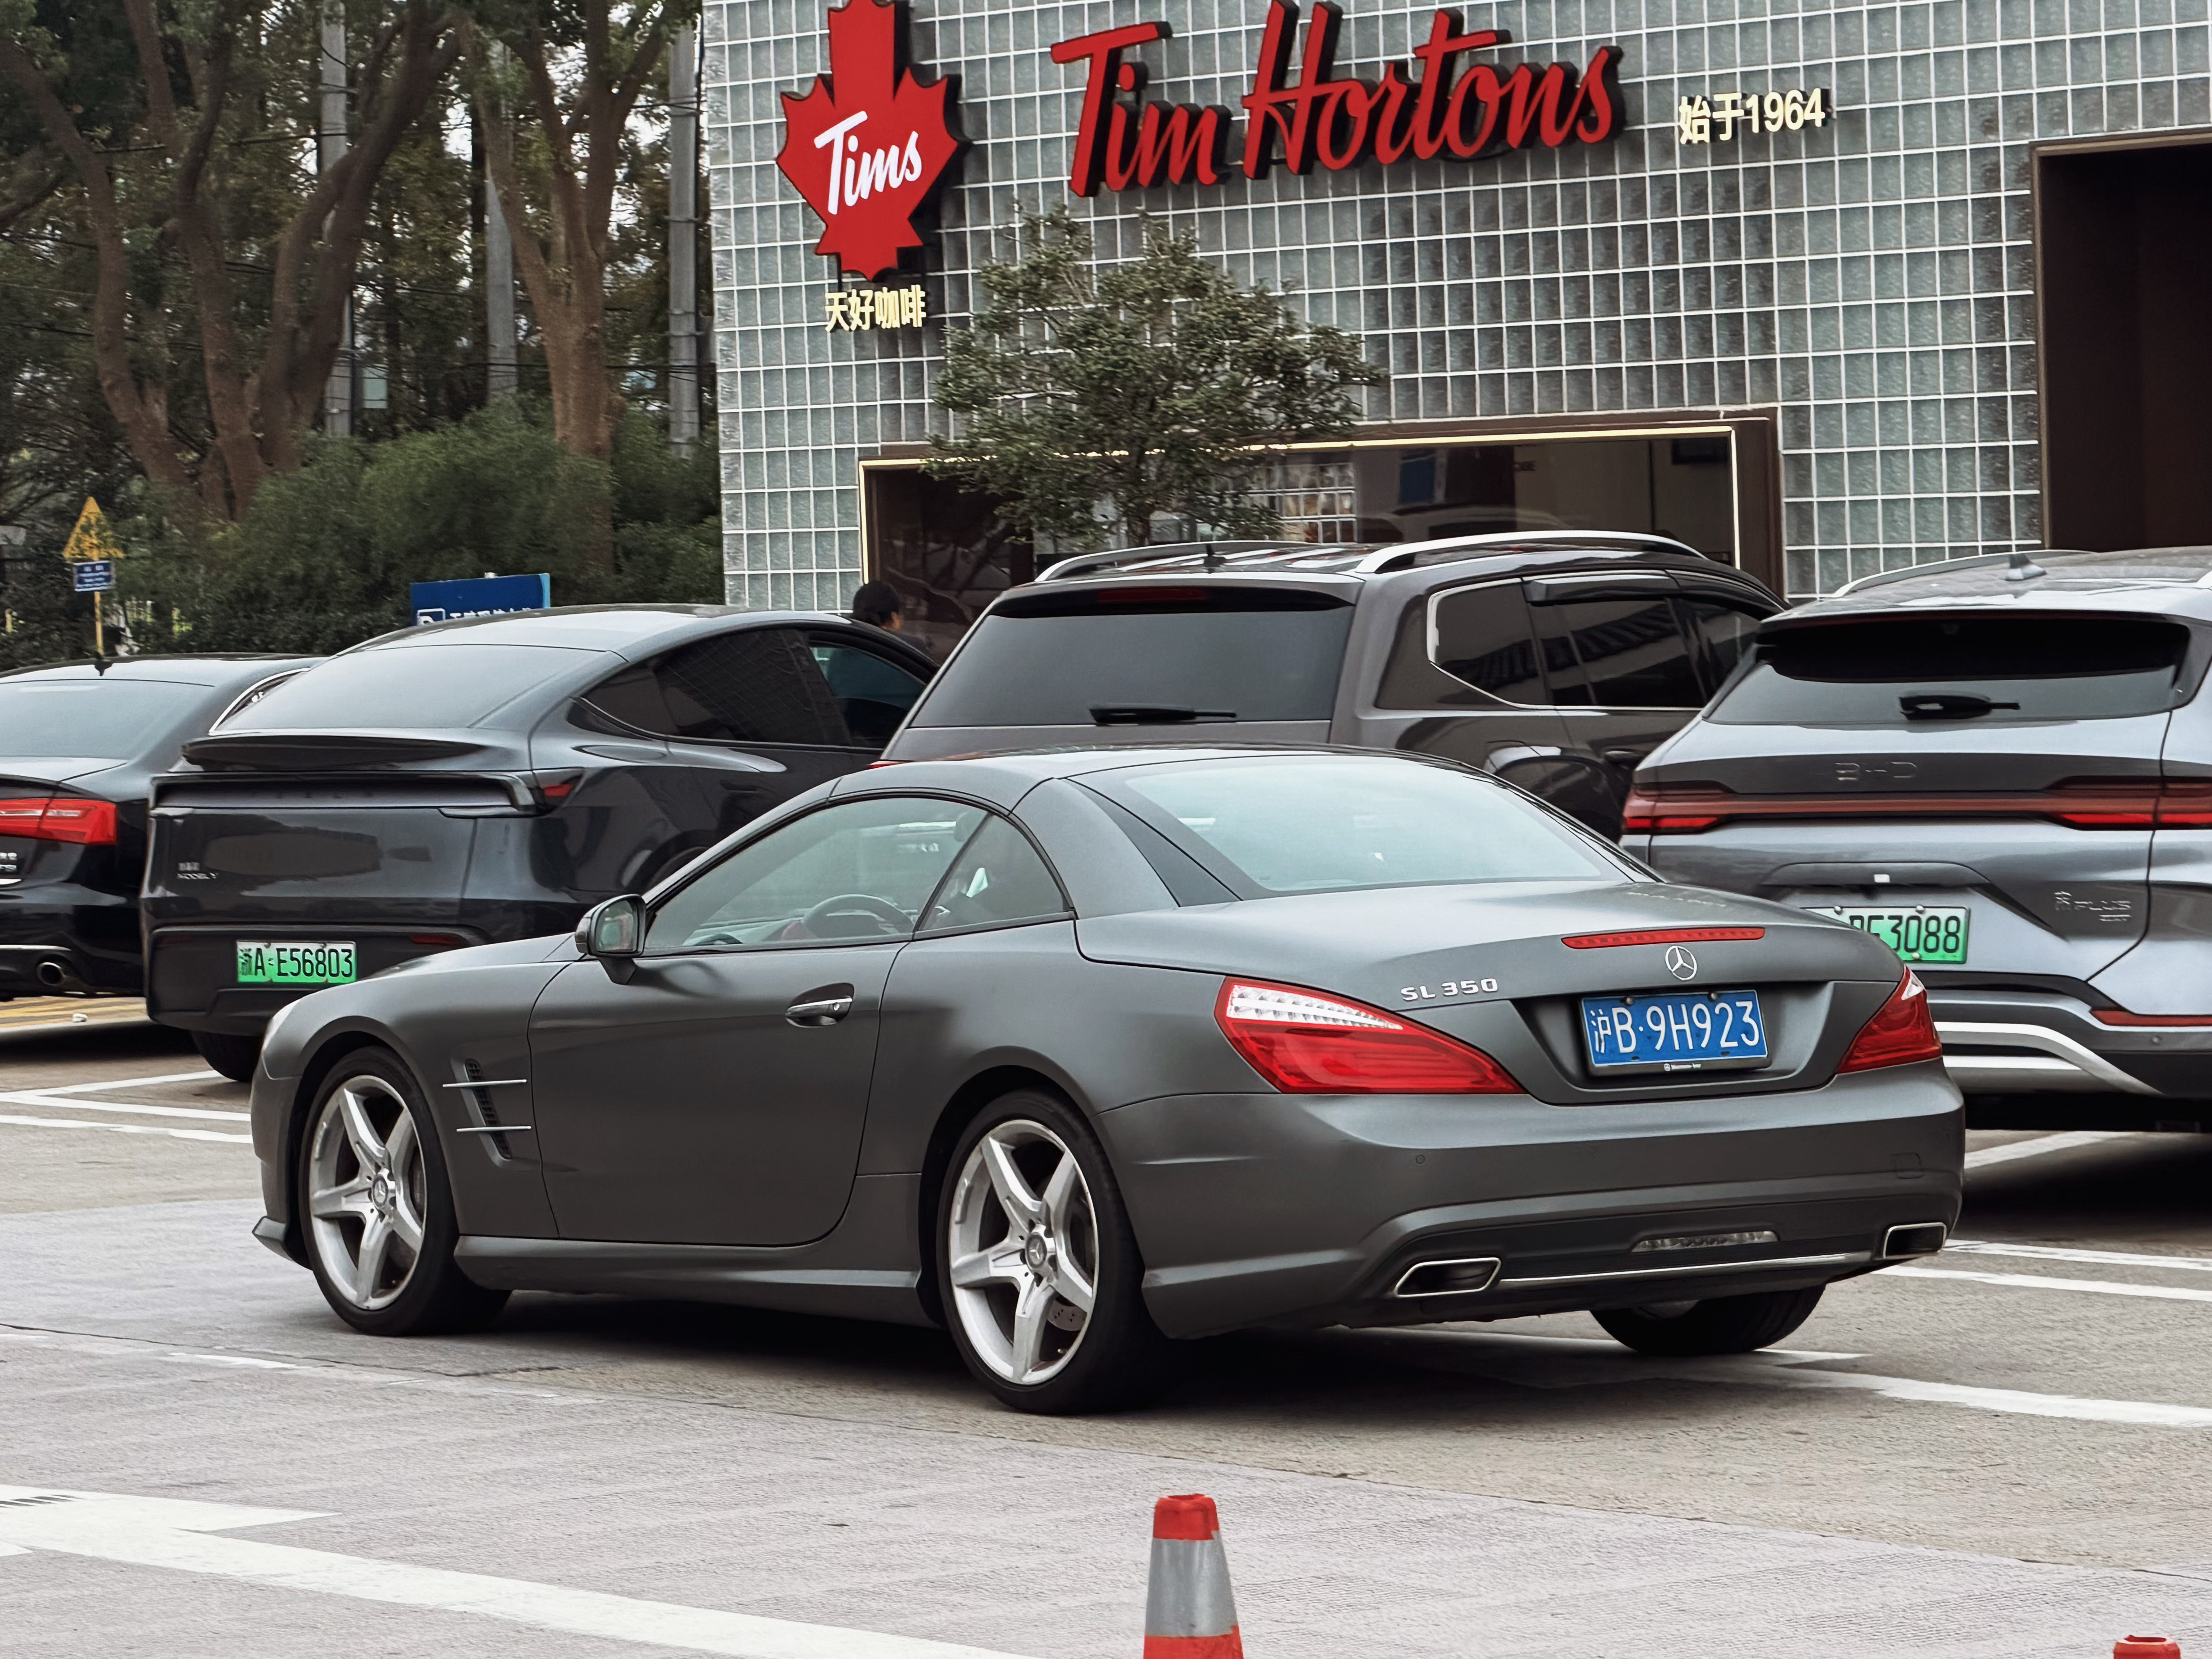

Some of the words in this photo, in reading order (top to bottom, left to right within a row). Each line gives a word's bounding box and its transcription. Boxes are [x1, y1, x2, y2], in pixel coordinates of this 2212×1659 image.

[1051, 21, 1220, 197] Tim
[1241, 0, 1613, 180] Hortons
[1679, 88, 1826, 144] 始于1964
[814, 111, 922, 215] Tims
[825, 284, 926, 331] 天好咖啡
[1400, 985, 1436, 1001] SL
[1442, 978, 1498, 996] 350
[1590, 1001, 1759, 1054] 沪B·9H923
